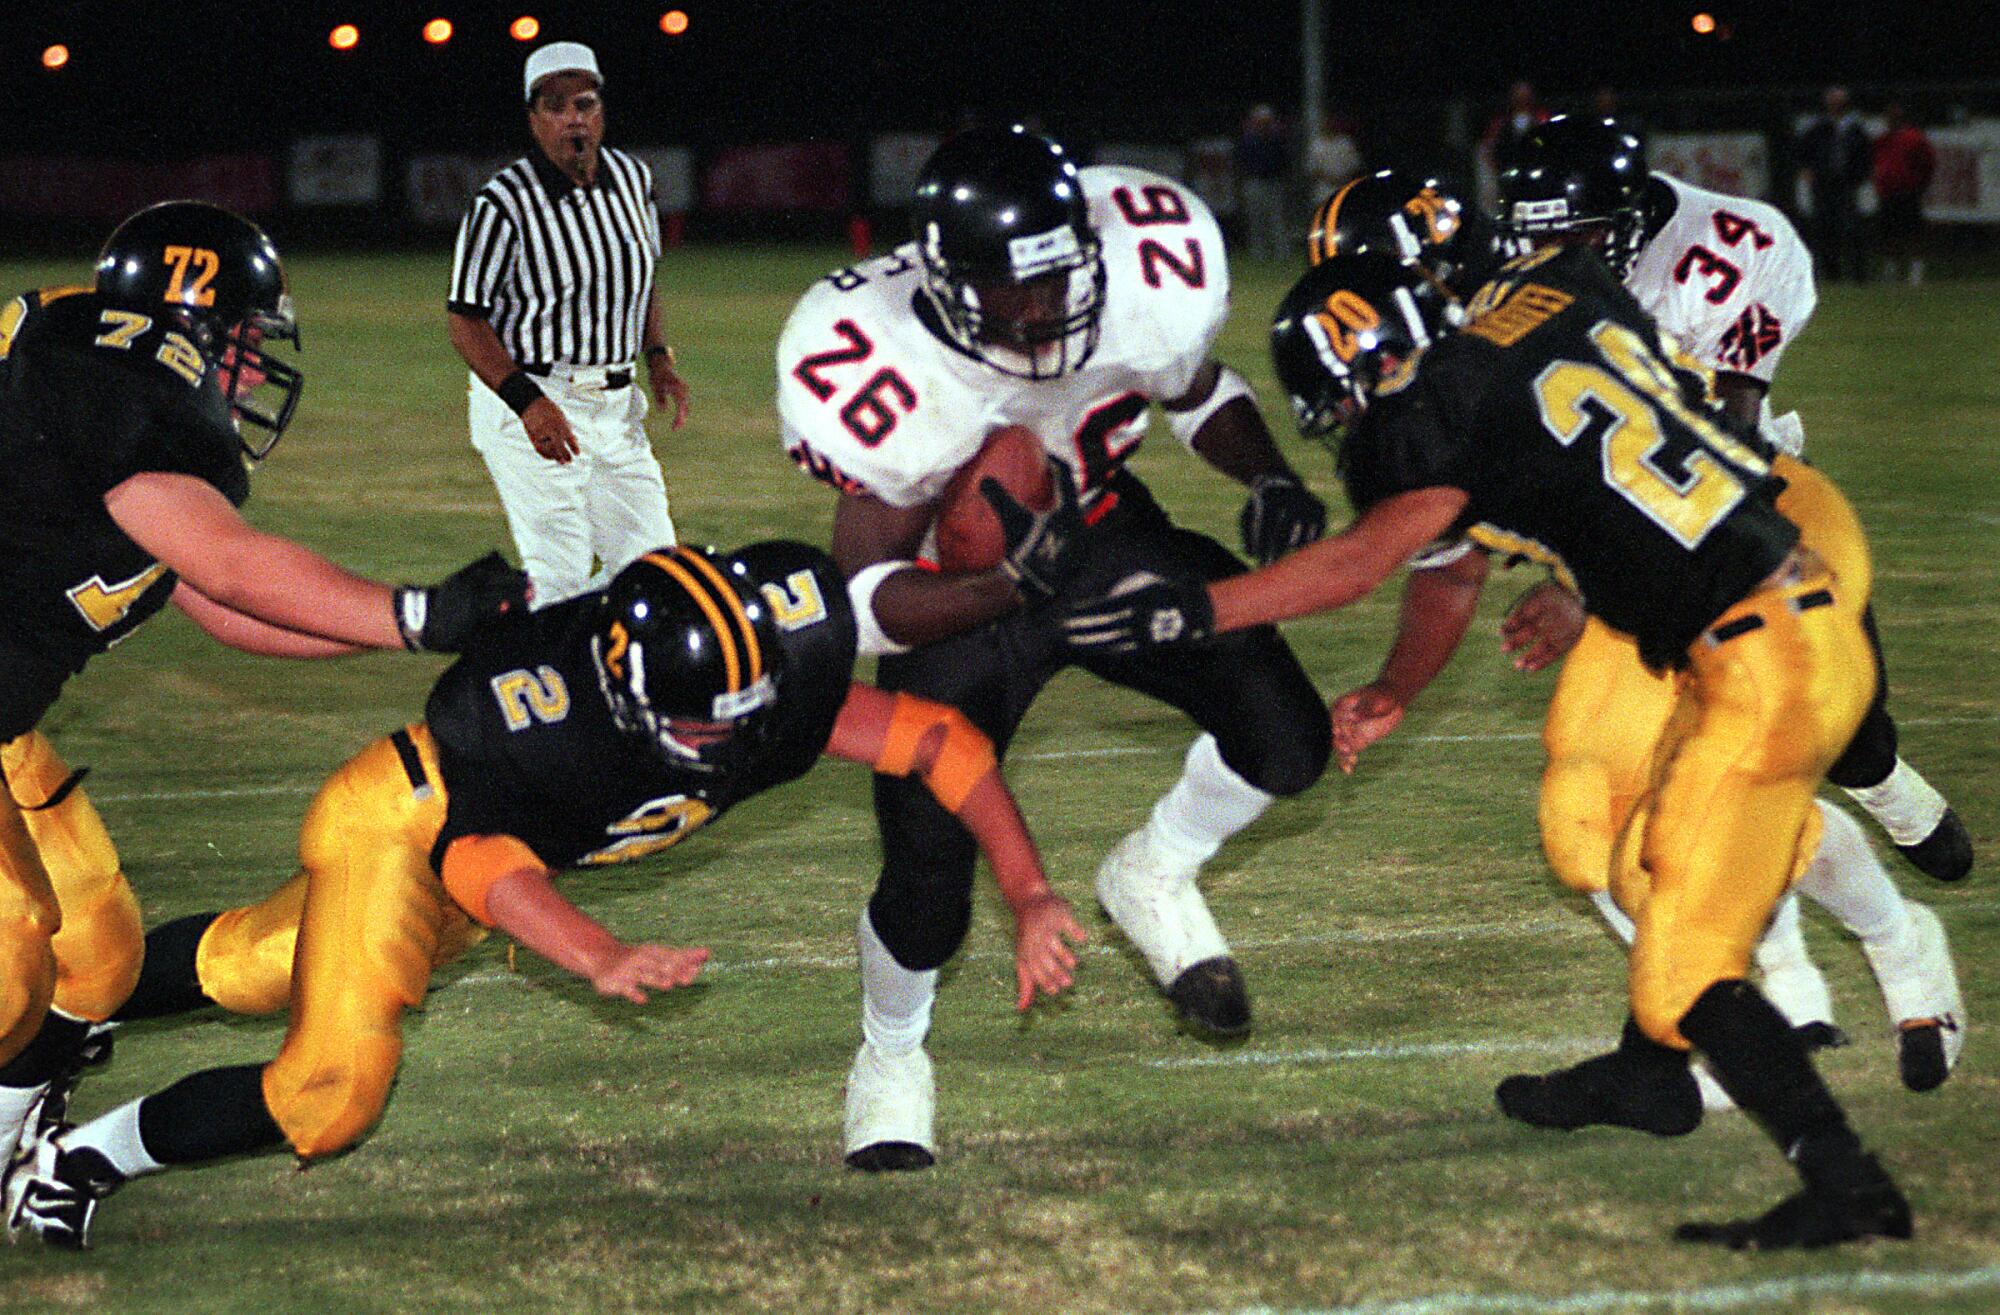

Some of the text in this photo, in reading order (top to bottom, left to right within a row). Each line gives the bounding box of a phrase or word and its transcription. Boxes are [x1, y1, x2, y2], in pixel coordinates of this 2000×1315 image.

[163, 245, 220, 307] 72
[1110, 186, 1206, 289] 26
[1673, 208, 1774, 305] 34
[94, 309, 206, 388] 72
[1317, 289, 1381, 363] 20
[792, 318, 918, 448] 26
[490, 664, 571, 732] 2
